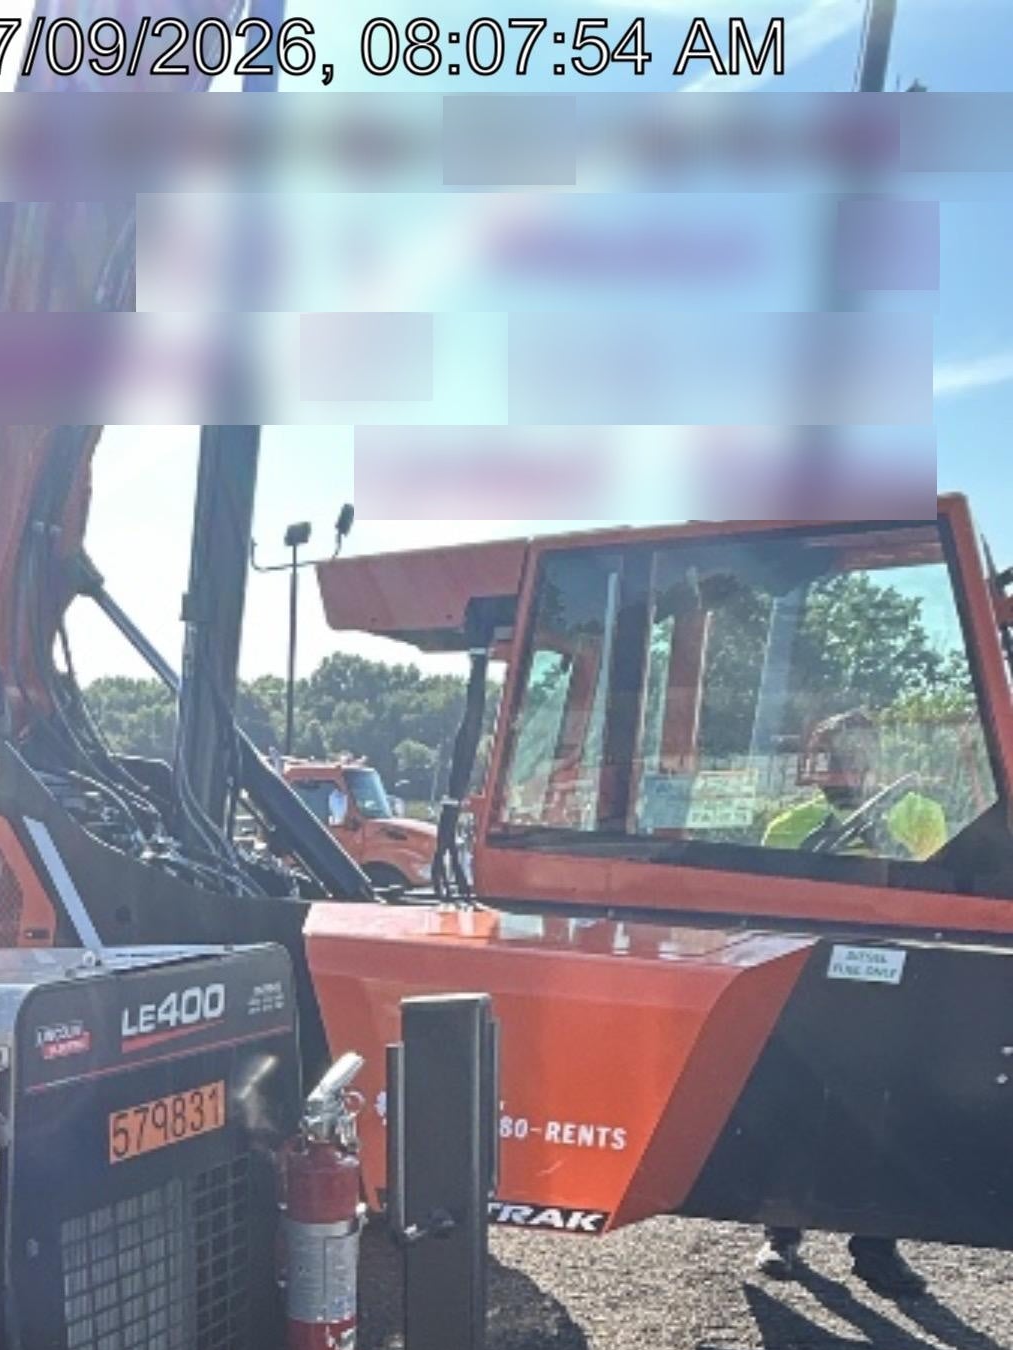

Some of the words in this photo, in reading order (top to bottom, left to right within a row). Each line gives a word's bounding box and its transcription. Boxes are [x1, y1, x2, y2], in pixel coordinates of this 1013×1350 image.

[121, 983, 225, 1036] LE400
[112, 1088, 220, 1158] 579831
[499, 1115, 628, 1150] 80-RENTS
[487, 1202, 604, 1232] TRAK
